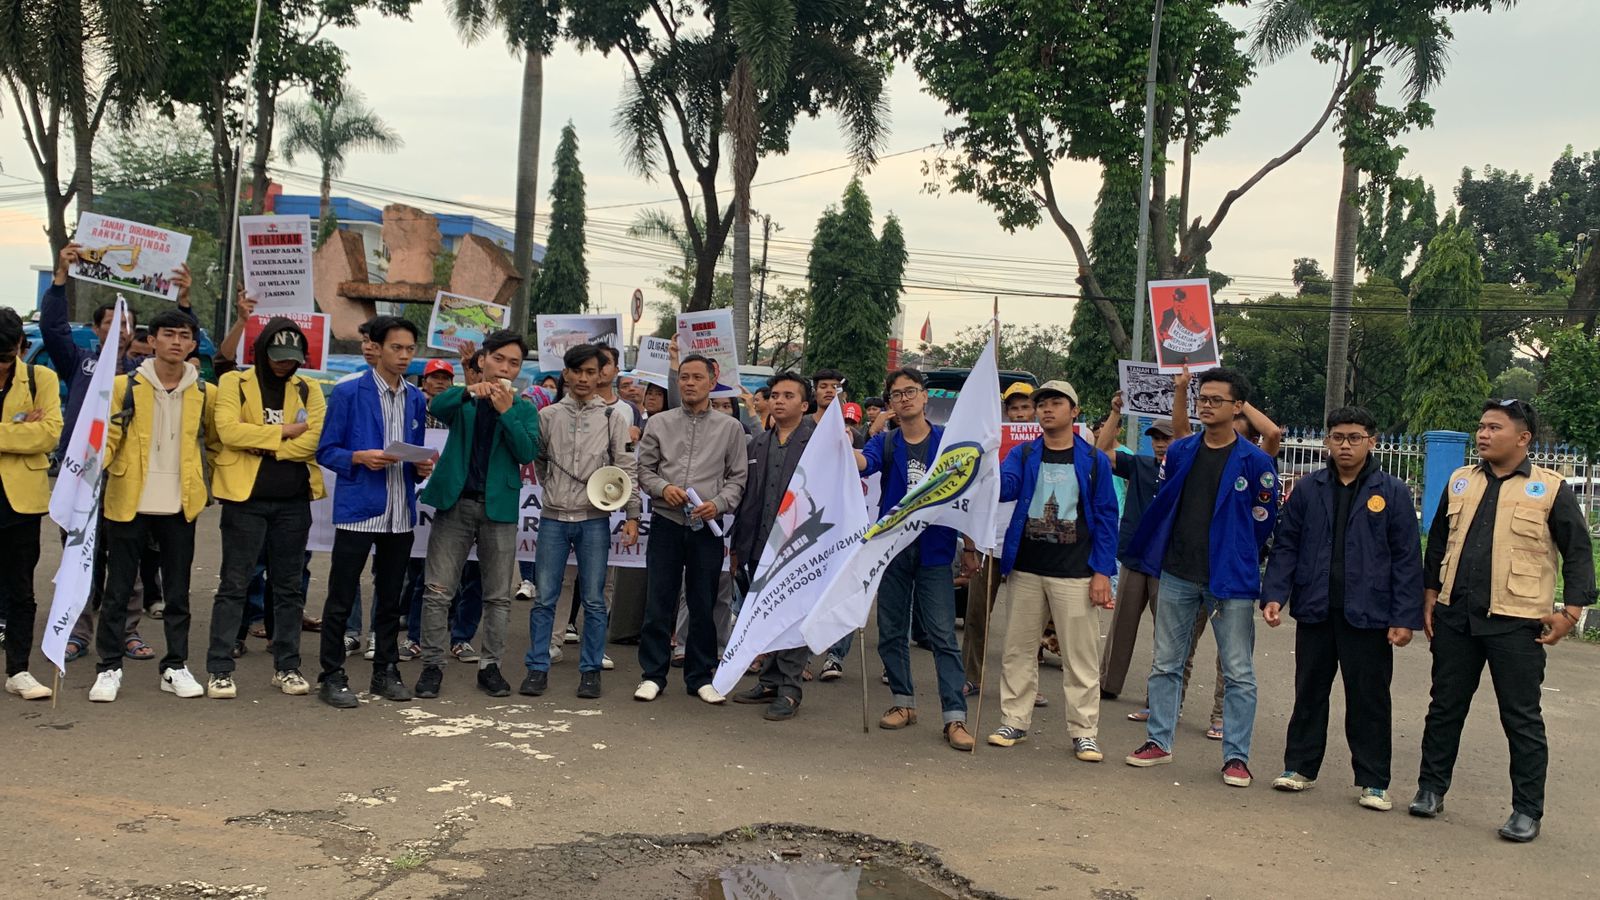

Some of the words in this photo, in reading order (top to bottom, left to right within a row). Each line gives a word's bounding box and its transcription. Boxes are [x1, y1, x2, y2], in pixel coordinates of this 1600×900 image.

[101, 219, 125, 232] TANAH
[129, 225, 168, 241] DIRAMPAS
[91, 227, 126, 242] RAKYAT
[129, 235, 171, 253] DITINDAS
[251, 233, 300, 246] HENTIKAN
[264, 290, 295, 298] JASINGA
[1010, 433, 1036, 441] TANAH
